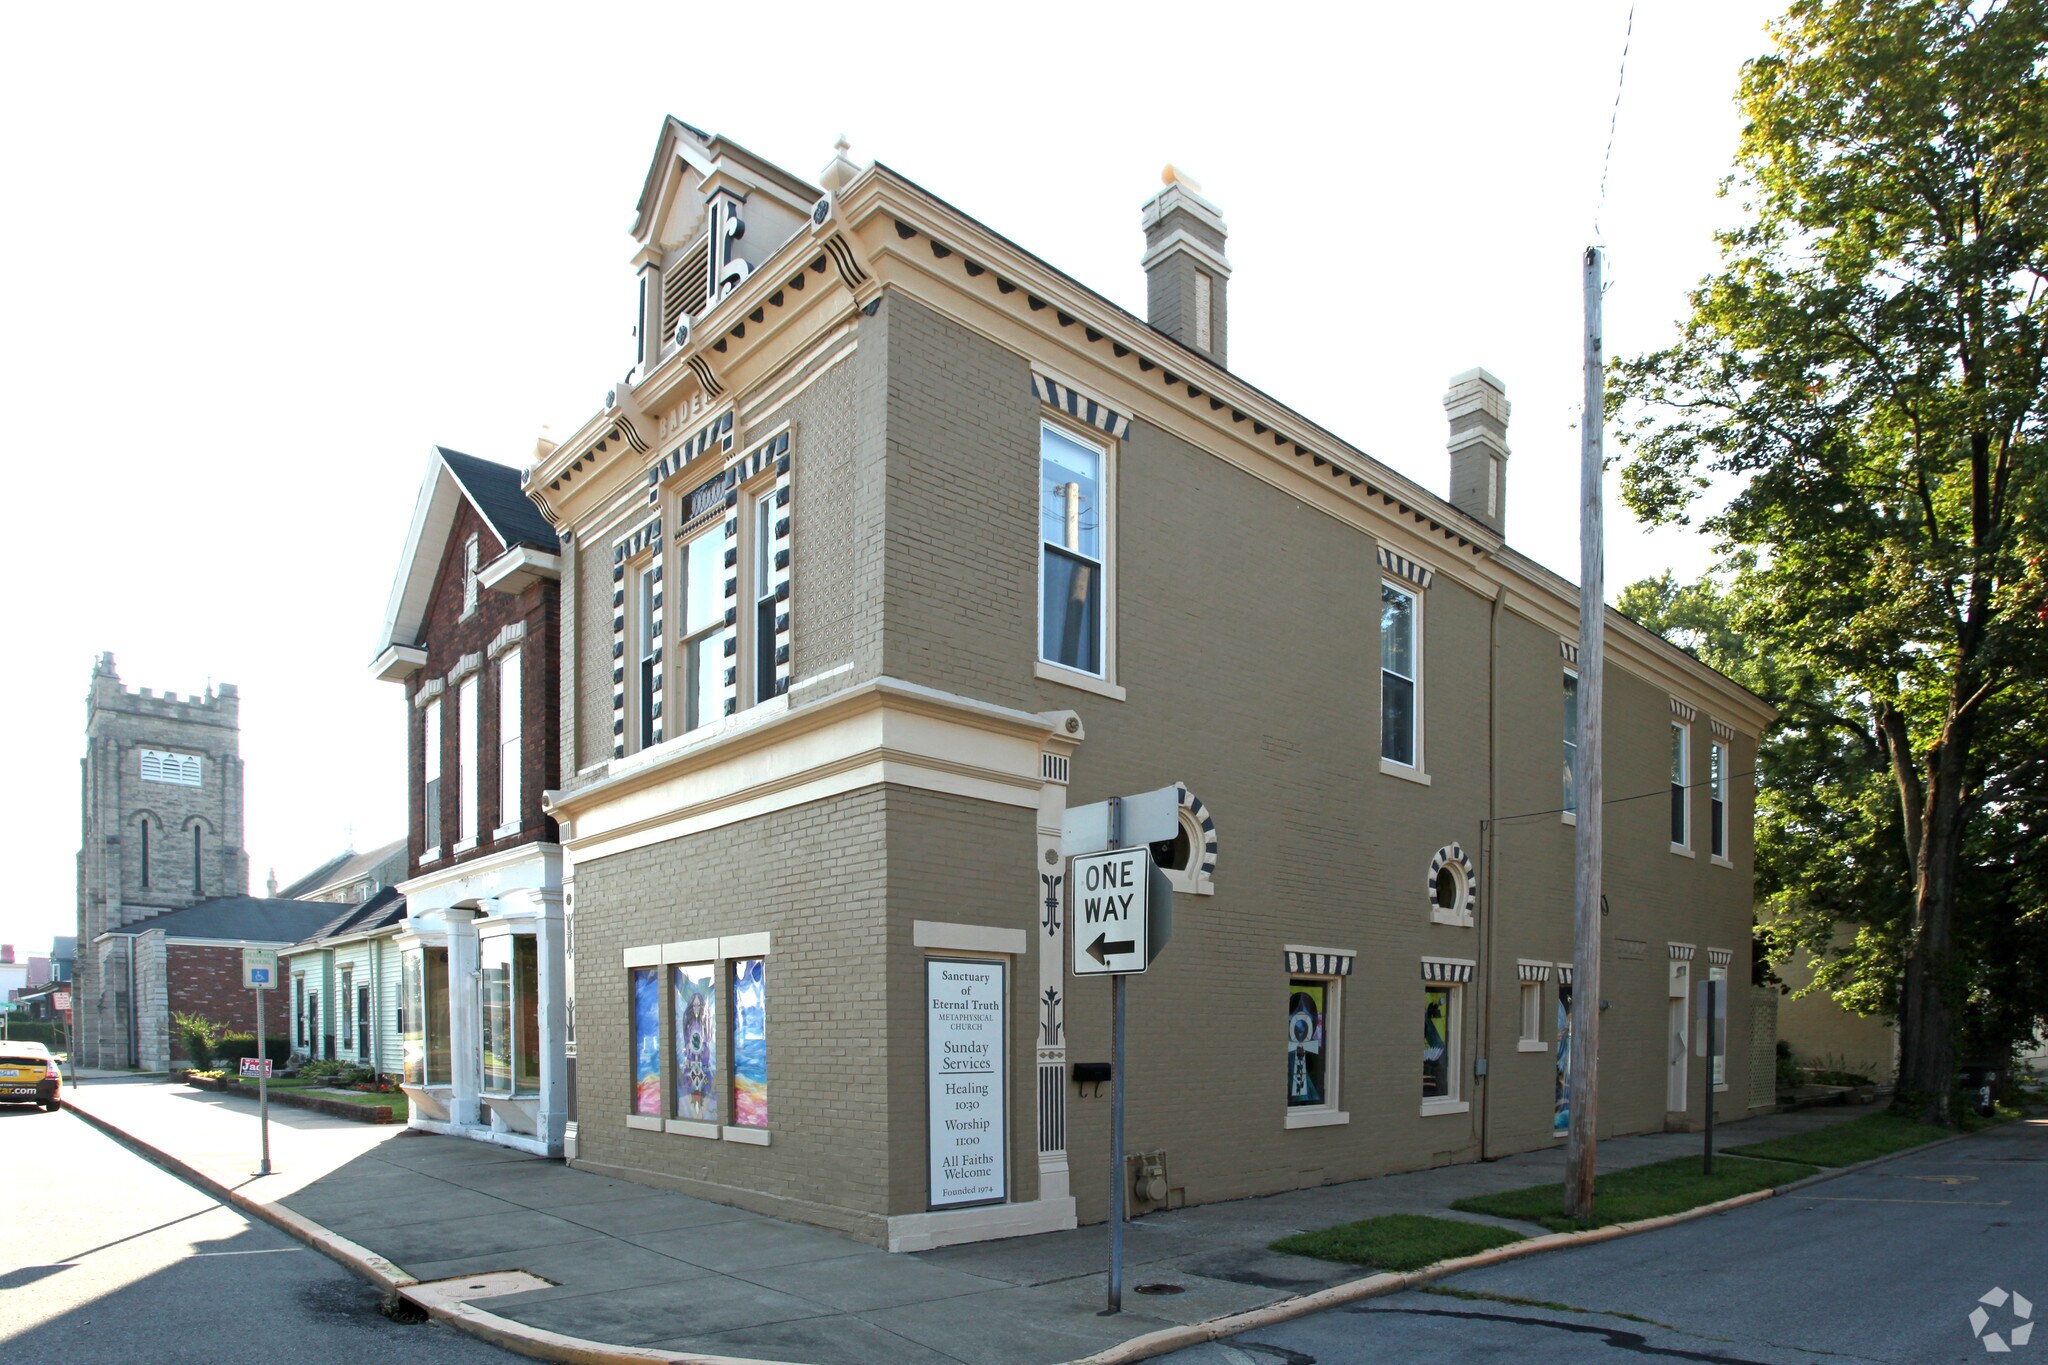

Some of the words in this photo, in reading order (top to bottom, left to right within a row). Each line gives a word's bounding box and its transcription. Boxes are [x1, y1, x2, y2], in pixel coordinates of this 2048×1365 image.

[1085, 860, 1134, 892] ONE
[1084, 893, 1135, 924] WAY
[941, 970, 990, 985] Sanctuary
[960, 985, 972, 996] of
[932, 998, 969, 1010] Eternal
[971, 999, 1000, 1011] Truth
[938, 1013, 994, 1022] METAPHYSICAL
[950, 1023, 983, 1031] CHURCH
[943, 1040, 990, 1057] Sunday
[942, 1056, 991, 1070] Services
[945, 1082, 989, 1097] Healing
[955, 1101, 980, 1111] 10:30
[945, 1117, 991, 1132] Worship
[956, 1136, 980, 1146] 11:00
[942, 1155, 959, 1168] All
[962, 1153, 994, 1166] Faiths
[944, 1167, 992, 1180] Welcome
[942, 1186, 976, 1197] Founded
